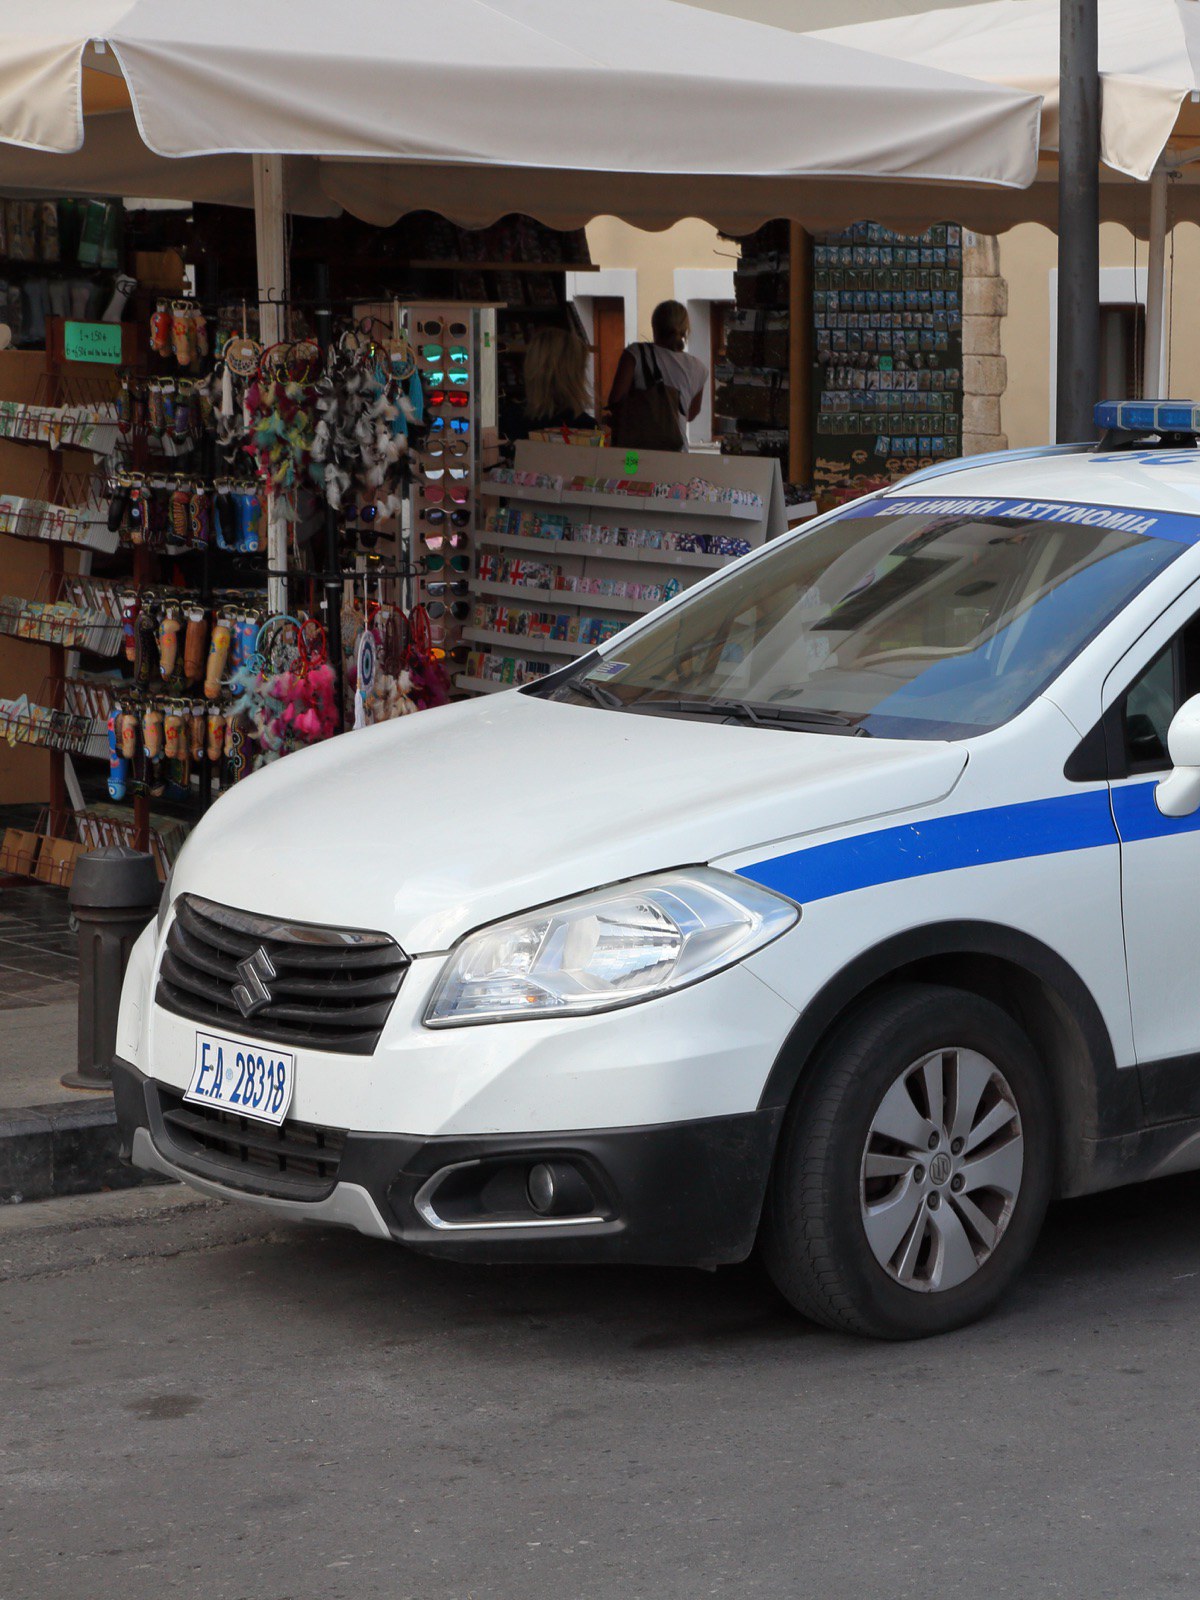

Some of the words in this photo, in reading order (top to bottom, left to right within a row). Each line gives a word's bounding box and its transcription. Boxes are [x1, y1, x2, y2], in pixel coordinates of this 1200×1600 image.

[874, 500, 1006, 517] ΕΛΛΗΝΙΚΗ
[1001, 501, 1159, 535] ΑΣΤΥΝΟΜΙΑ
[228, 1051, 286, 1114] 28318
